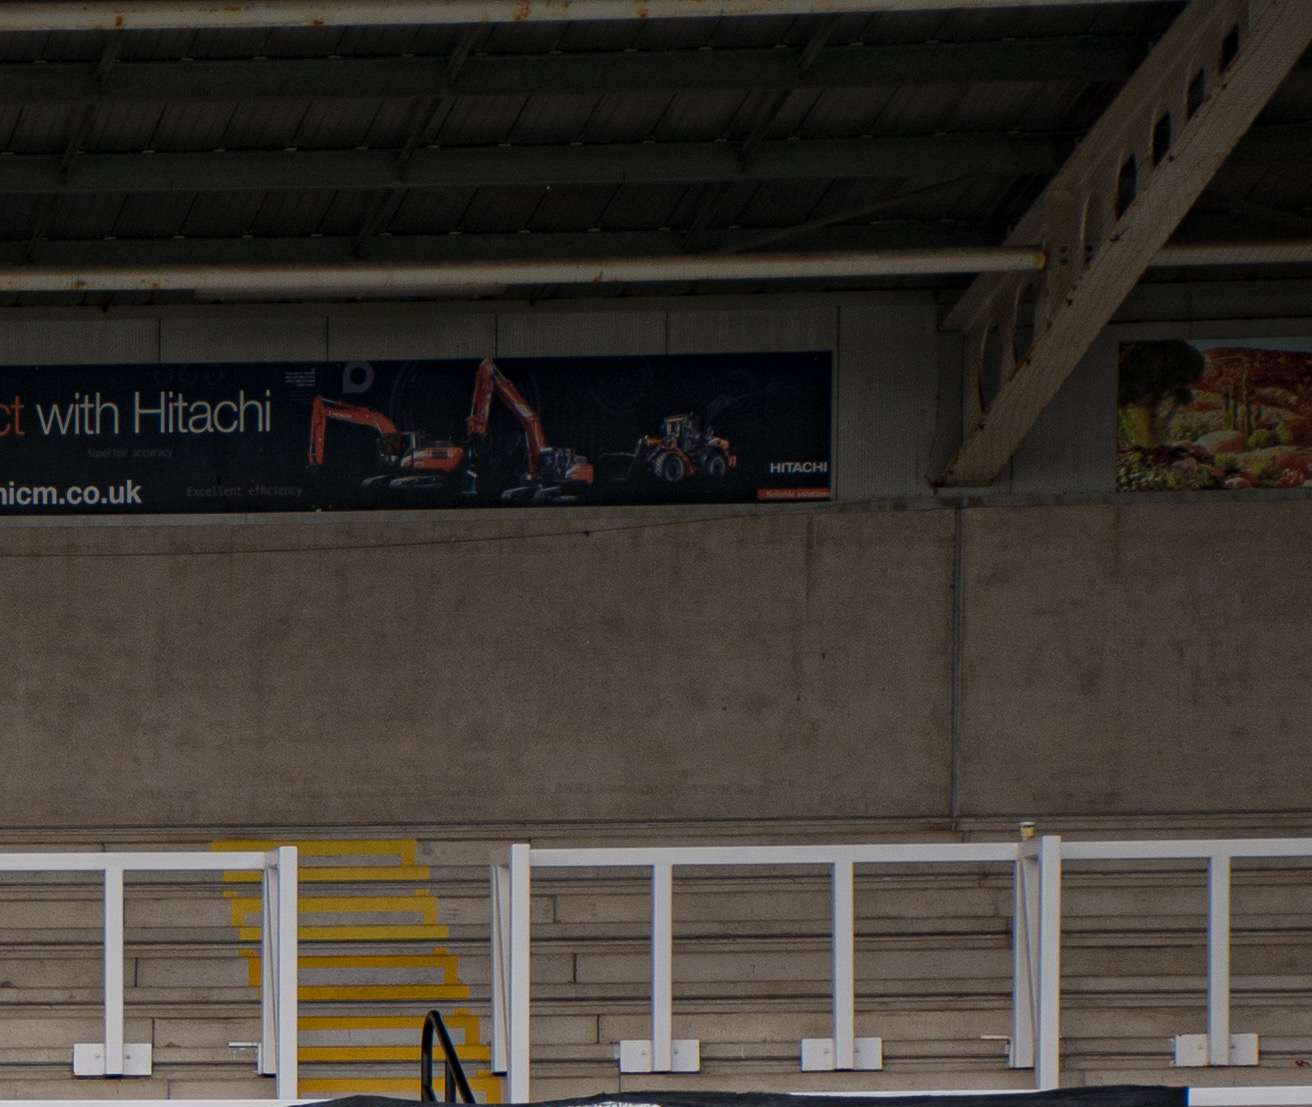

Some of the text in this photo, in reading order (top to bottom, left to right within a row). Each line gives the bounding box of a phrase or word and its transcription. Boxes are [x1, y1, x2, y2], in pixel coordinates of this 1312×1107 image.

[36, 391, 120, 437] with
[133, 389, 272, 435] Hitachi
[769, 461, 829, 474] HITACHI
[186, 484, 242, 497] Excellent
